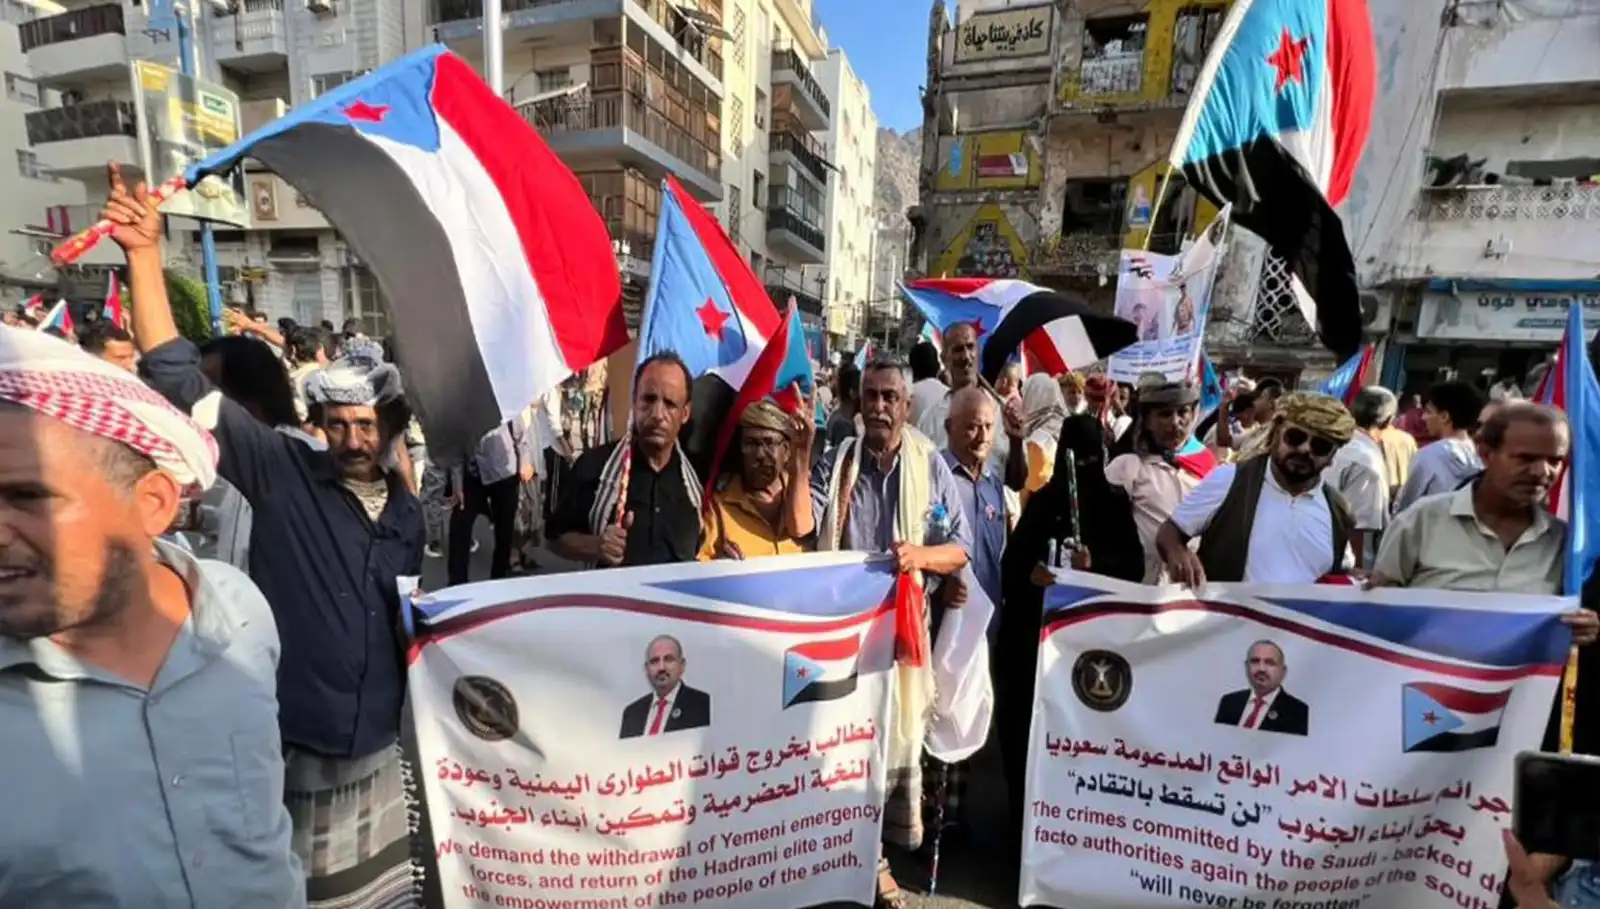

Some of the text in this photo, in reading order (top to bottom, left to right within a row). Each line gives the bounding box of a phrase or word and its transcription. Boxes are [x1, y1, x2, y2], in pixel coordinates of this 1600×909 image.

[964, 25, 987, 51] حياة
[746, 736, 810, 772] بخروج
[816, 718, 876, 756] نطالب
[1046, 731, 1107, 758] سعوديا
[688, 746, 740, 779] قوات
[1114, 738, 1211, 772] المدعومة
[1217, 755, 1279, 788] الواقع
[436, 758, 502, 789] وعودة
[506, 768, 590, 799] اليمنية
[811, 757, 871, 792] النخبة
[702, 774, 805, 818] الحضرمية
[1159, 782, 1226, 816] تسقط
[1354, 782, 1434, 808] سلطات
[596, 800, 696, 836] وتمكين
[1278, 817, 1365, 849] الجنوب
[1414, 814, 1466, 846] بحق
[469, 841, 544, 864] demand
[550, 850, 581, 866] the
[588, 842, 691, 867] withdrawal
[697, 835, 715, 854] of
[720, 820, 786, 849] Yemeni
[790, 804, 882, 833] emergency
[1032, 800, 1060, 818] The
[1066, 806, 1127, 828] crimes
[1132, 816, 1239, 854] committed
[1247, 837, 1272, 867] by
[1280, 850, 1315, 870] the
[1322, 851, 1376, 870] Saudi
[1393, 844, 1473, 878] backed
[470, 828, 854, 889] forces, and return of the Hadrami elite and
[1034, 826, 1078, 846] facto
[1083, 834, 1184, 871] authorities
[1191, 858, 1248, 886] again
[1255, 872, 1288, 892] the
[1294, 876, 1360, 898] people
[1364, 873, 1384, 888] of
[1386, 868, 1417, 883] the
[462, 850, 862, 909] the empowerment of the people of the south,
[1179, 884, 1237, 908] never
[1242, 896, 1266, 909] be
